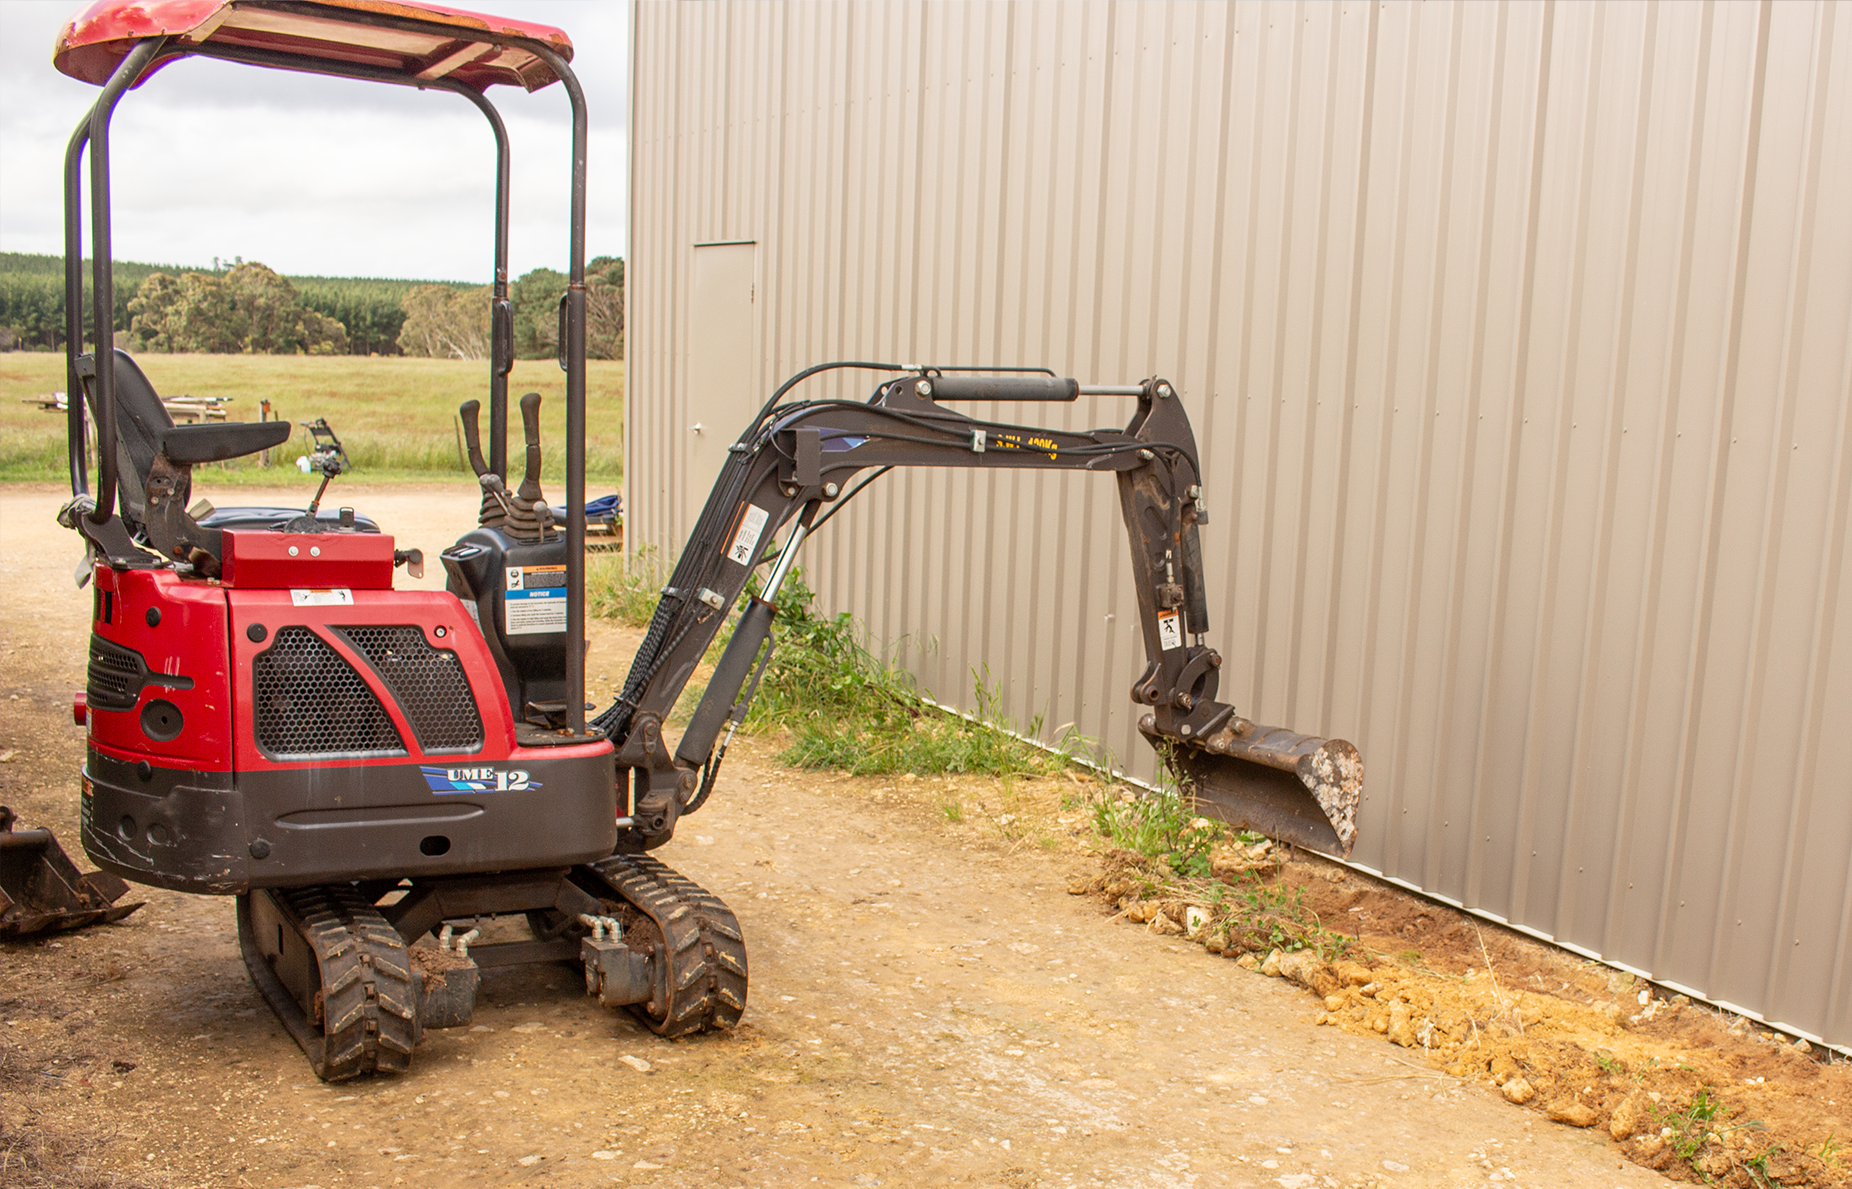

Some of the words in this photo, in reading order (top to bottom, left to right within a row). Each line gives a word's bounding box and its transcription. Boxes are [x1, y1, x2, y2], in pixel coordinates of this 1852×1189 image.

[529, 590, 550, 598] NOTICE
[446, 767, 495, 782] UME
[494, 769, 530, 792] 12
